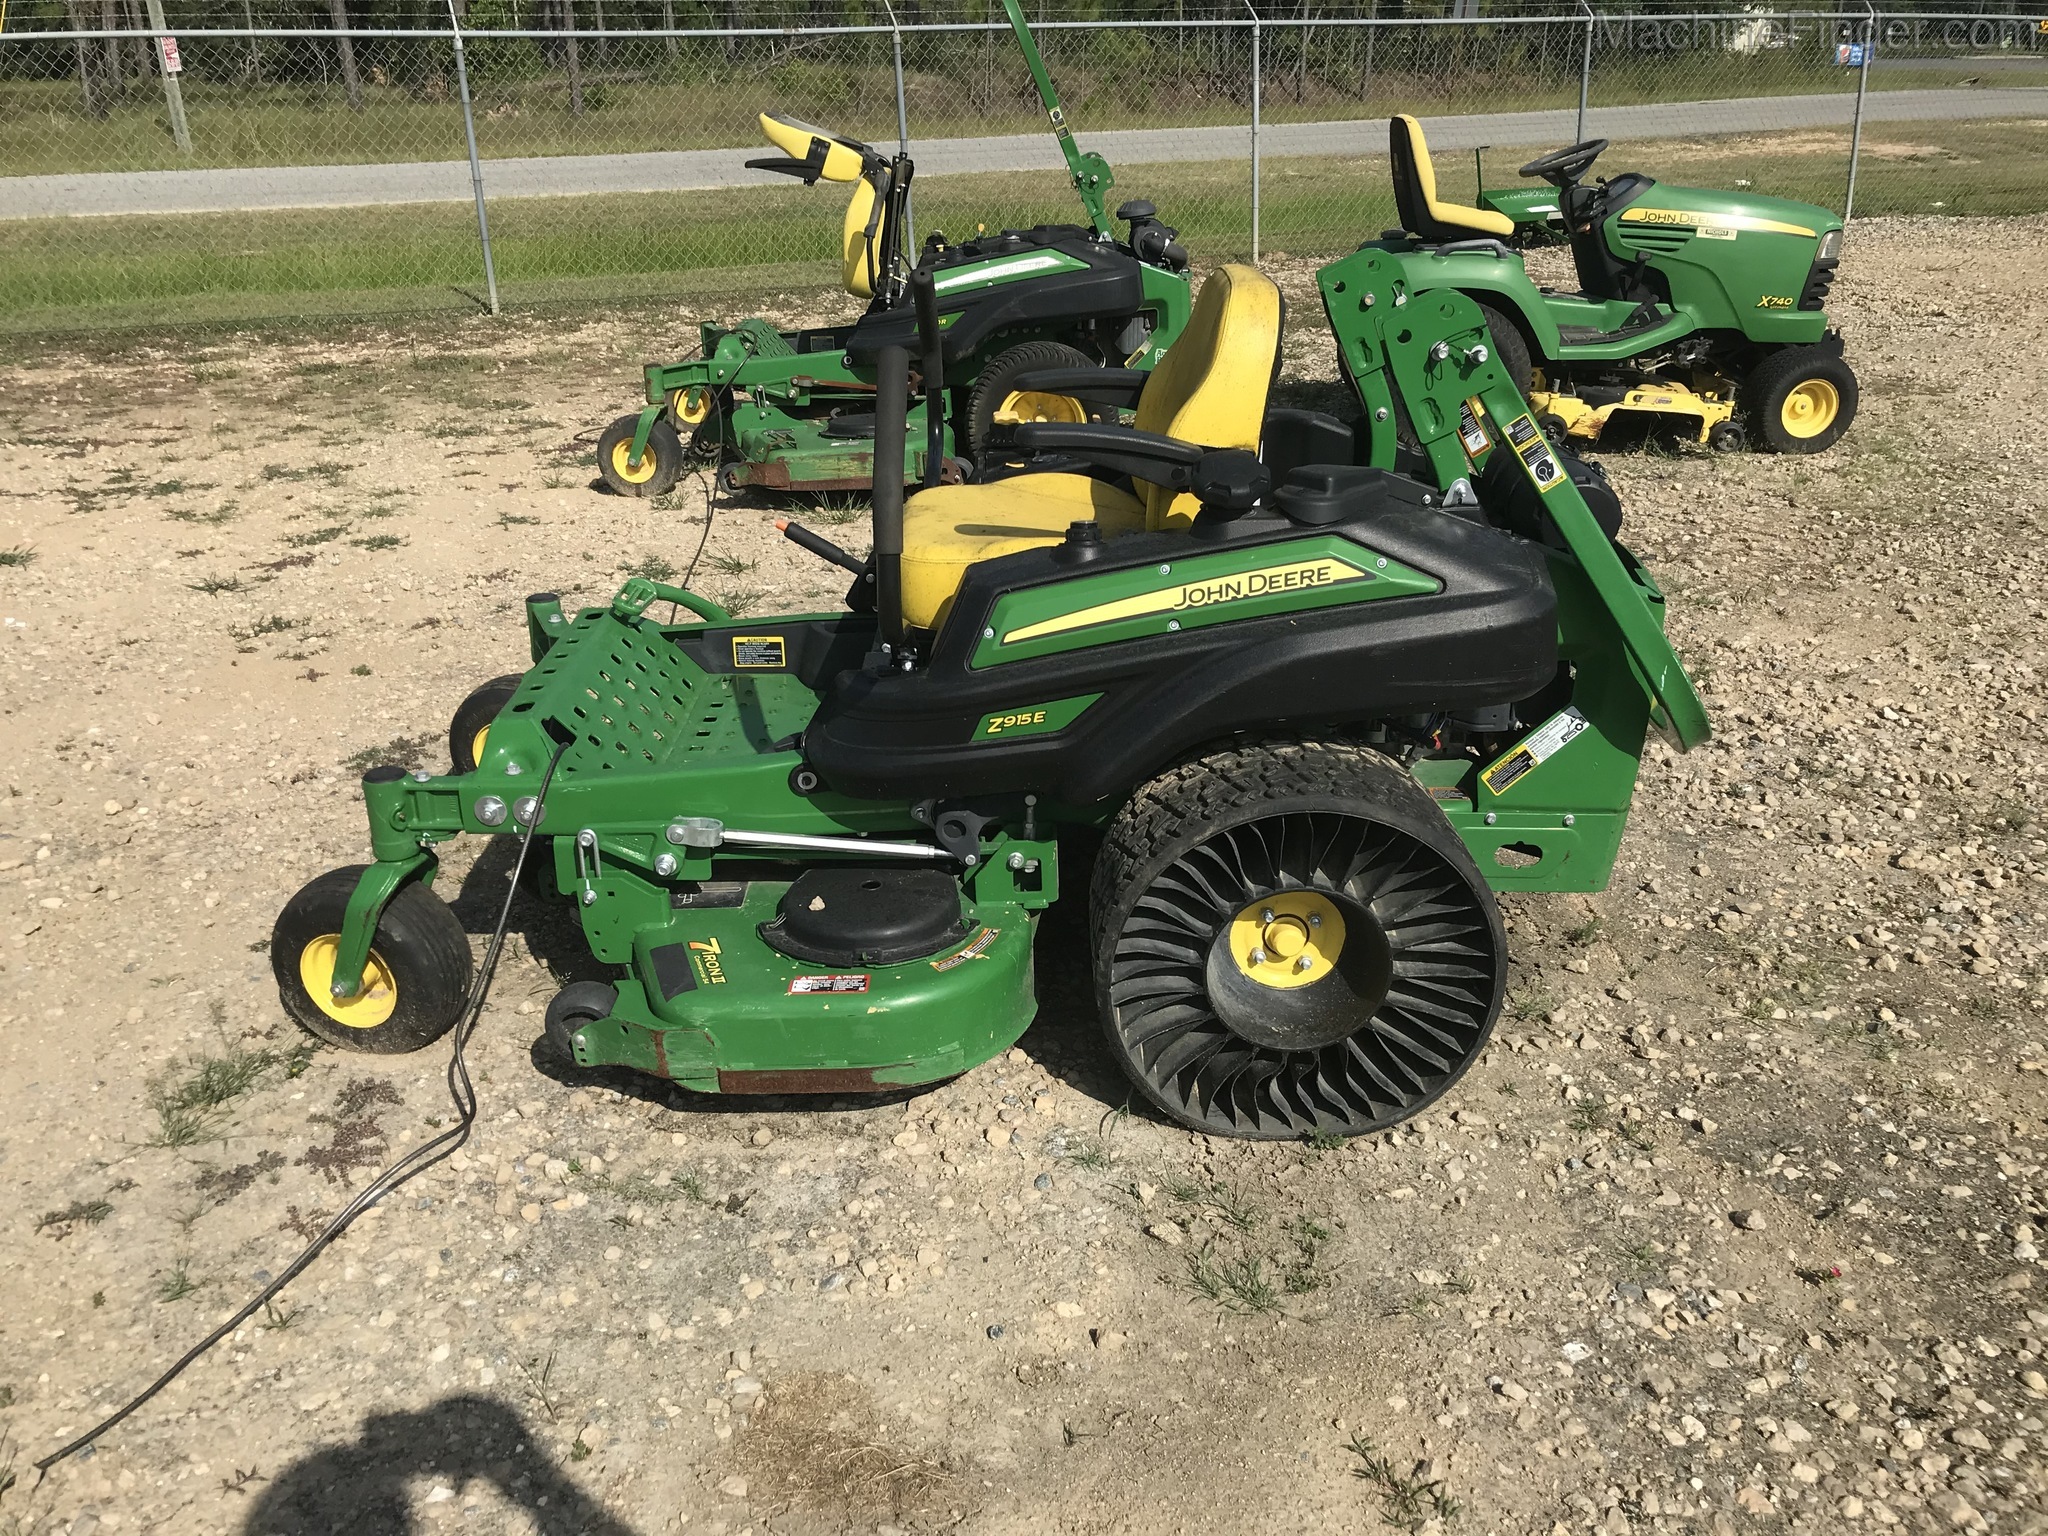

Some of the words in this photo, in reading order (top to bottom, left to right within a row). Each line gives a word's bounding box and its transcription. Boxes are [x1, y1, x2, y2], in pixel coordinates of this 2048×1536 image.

[1639, 211, 1677, 223] JOHN
[1756, 295, 1794, 307] X740
[1174, 581, 1242, 608] JOHN
[1248, 566, 1331, 594] DEERE
